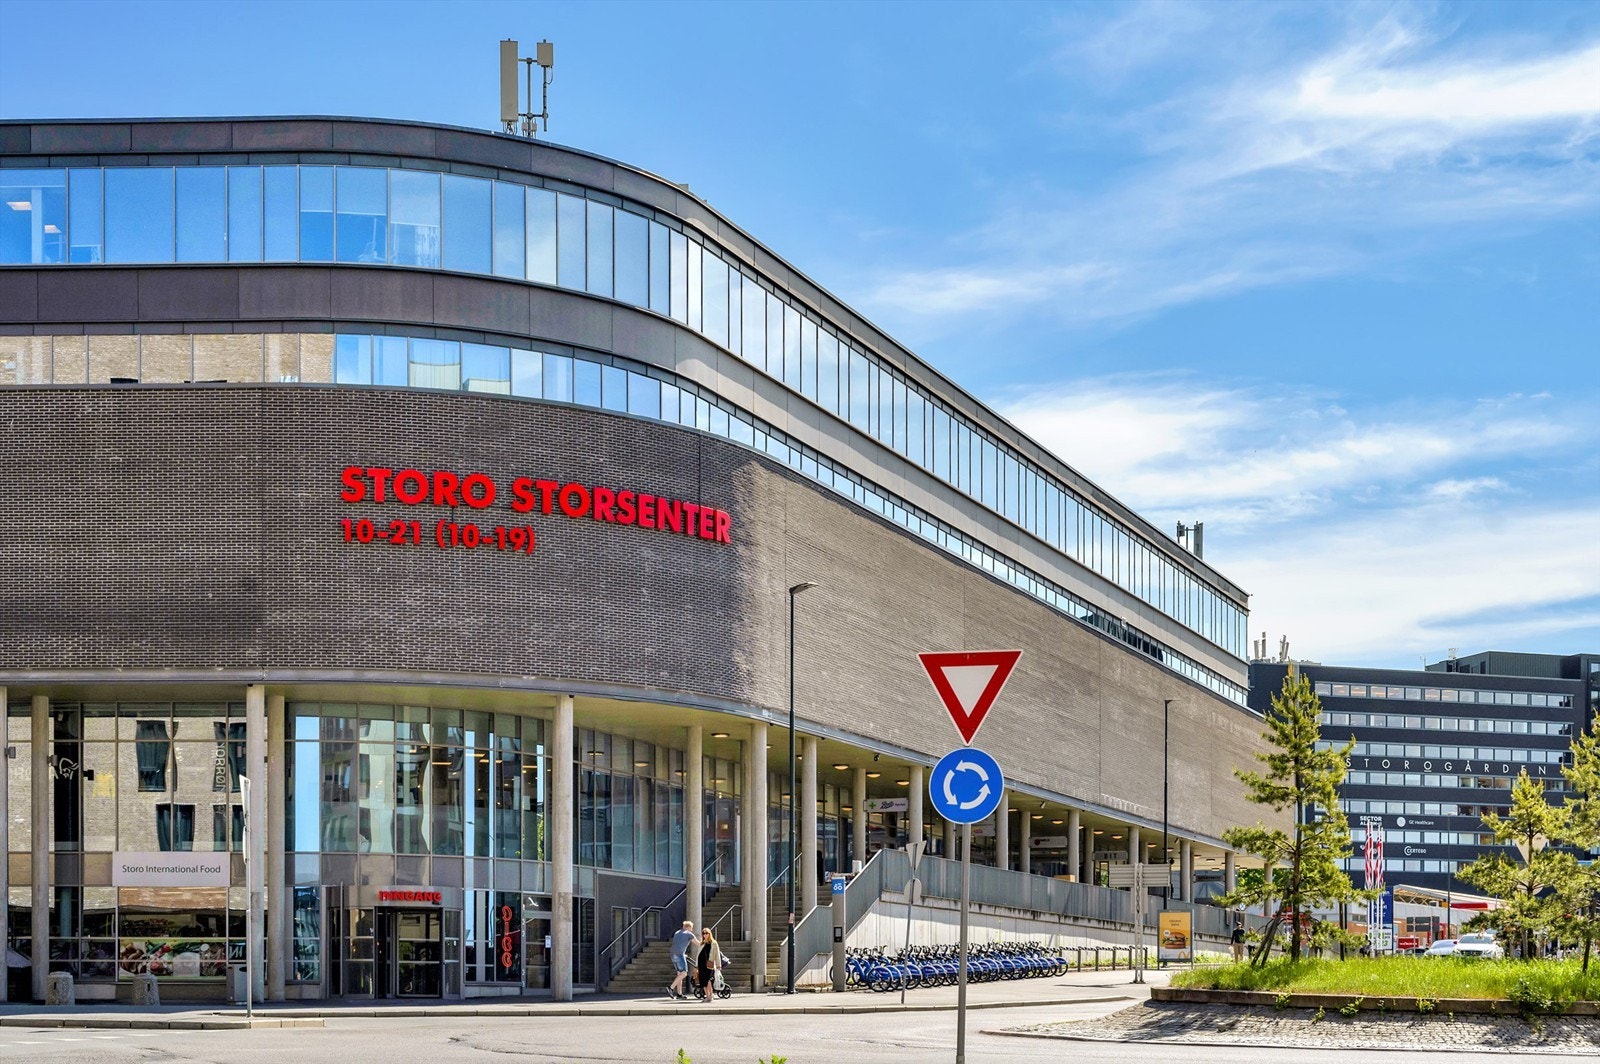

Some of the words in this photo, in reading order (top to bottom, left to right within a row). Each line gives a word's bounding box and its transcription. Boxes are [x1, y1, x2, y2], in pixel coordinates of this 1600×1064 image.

[341, 466, 496, 508] STORO
[512, 477, 731, 543] STORSENTER
[341, 519, 421, 544] 10-21
[436, 519, 535, 554] (10-19)
[1345, 758, 1546, 774] STOROGÅRDEN
[122, 865, 144, 873] Storo
[146, 865, 198, 873] International
[200, 865, 221, 873] Food
[378, 890, 442, 902] INNGANG
